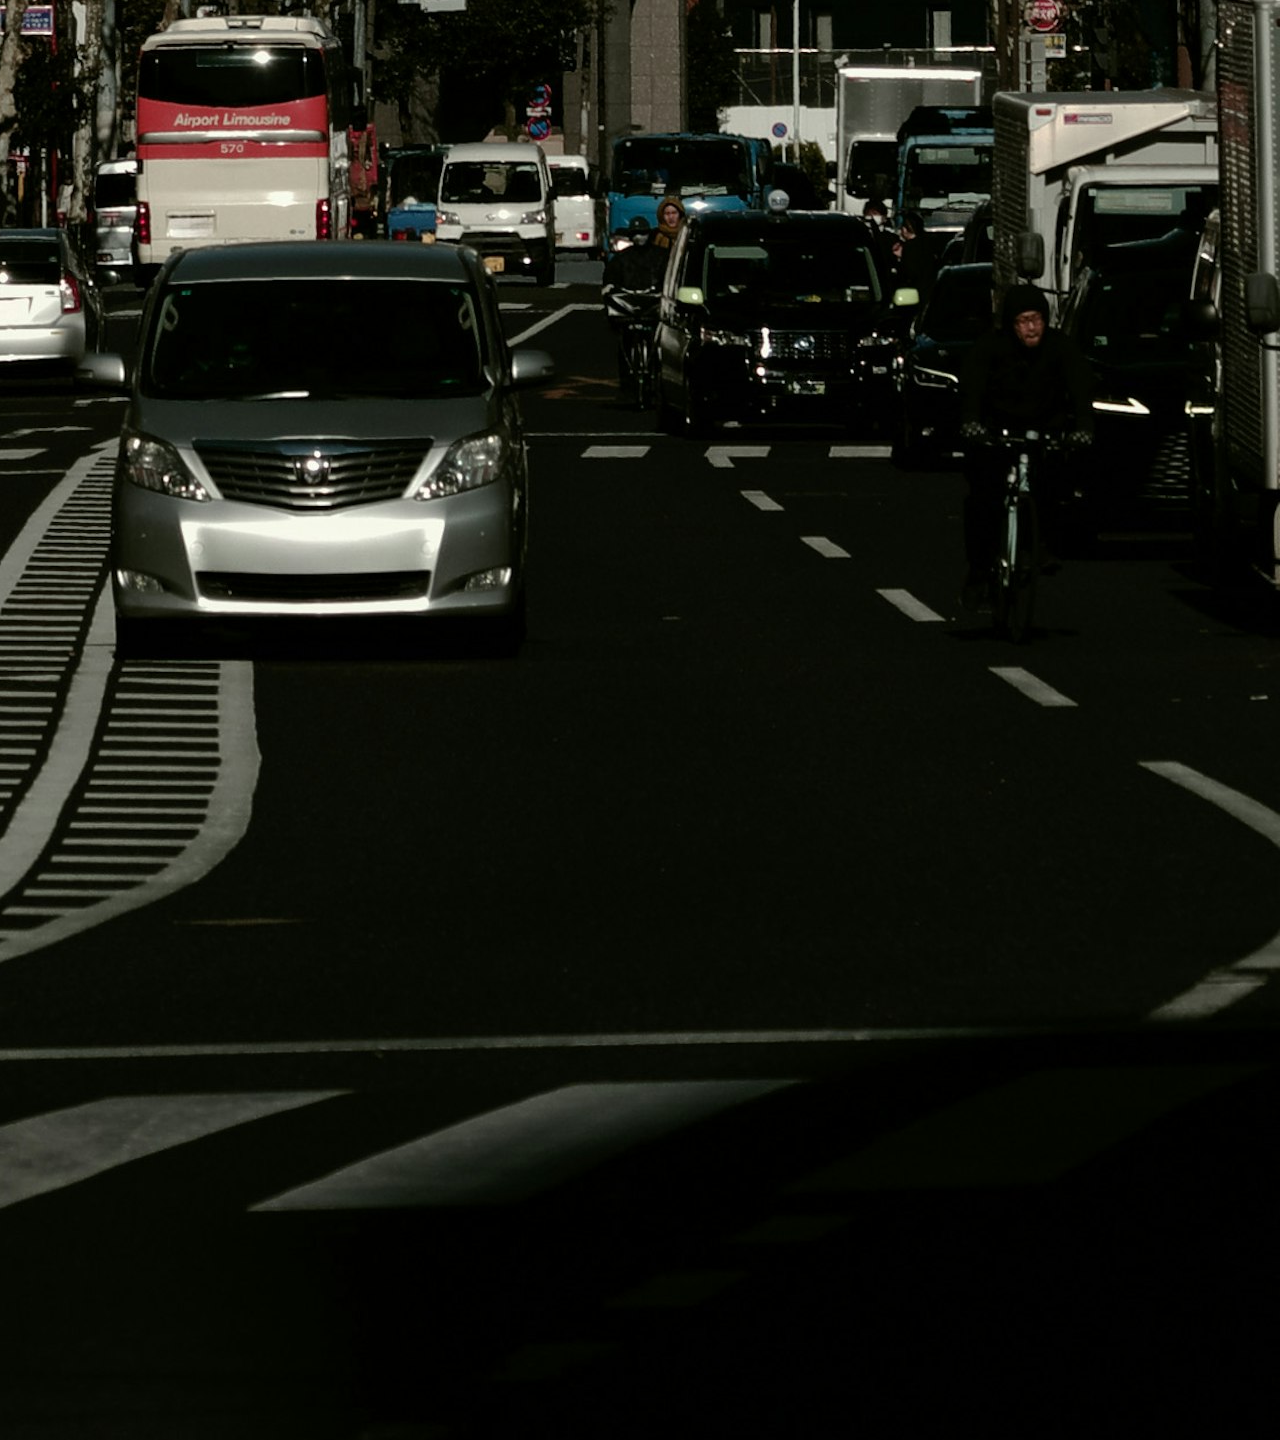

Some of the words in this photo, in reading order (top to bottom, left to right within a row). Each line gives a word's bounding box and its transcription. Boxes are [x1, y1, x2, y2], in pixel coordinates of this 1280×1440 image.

[173, 113, 219, 128] Airport
[222, 112, 291, 126] Limousine
[220, 143, 244, 154] 570
